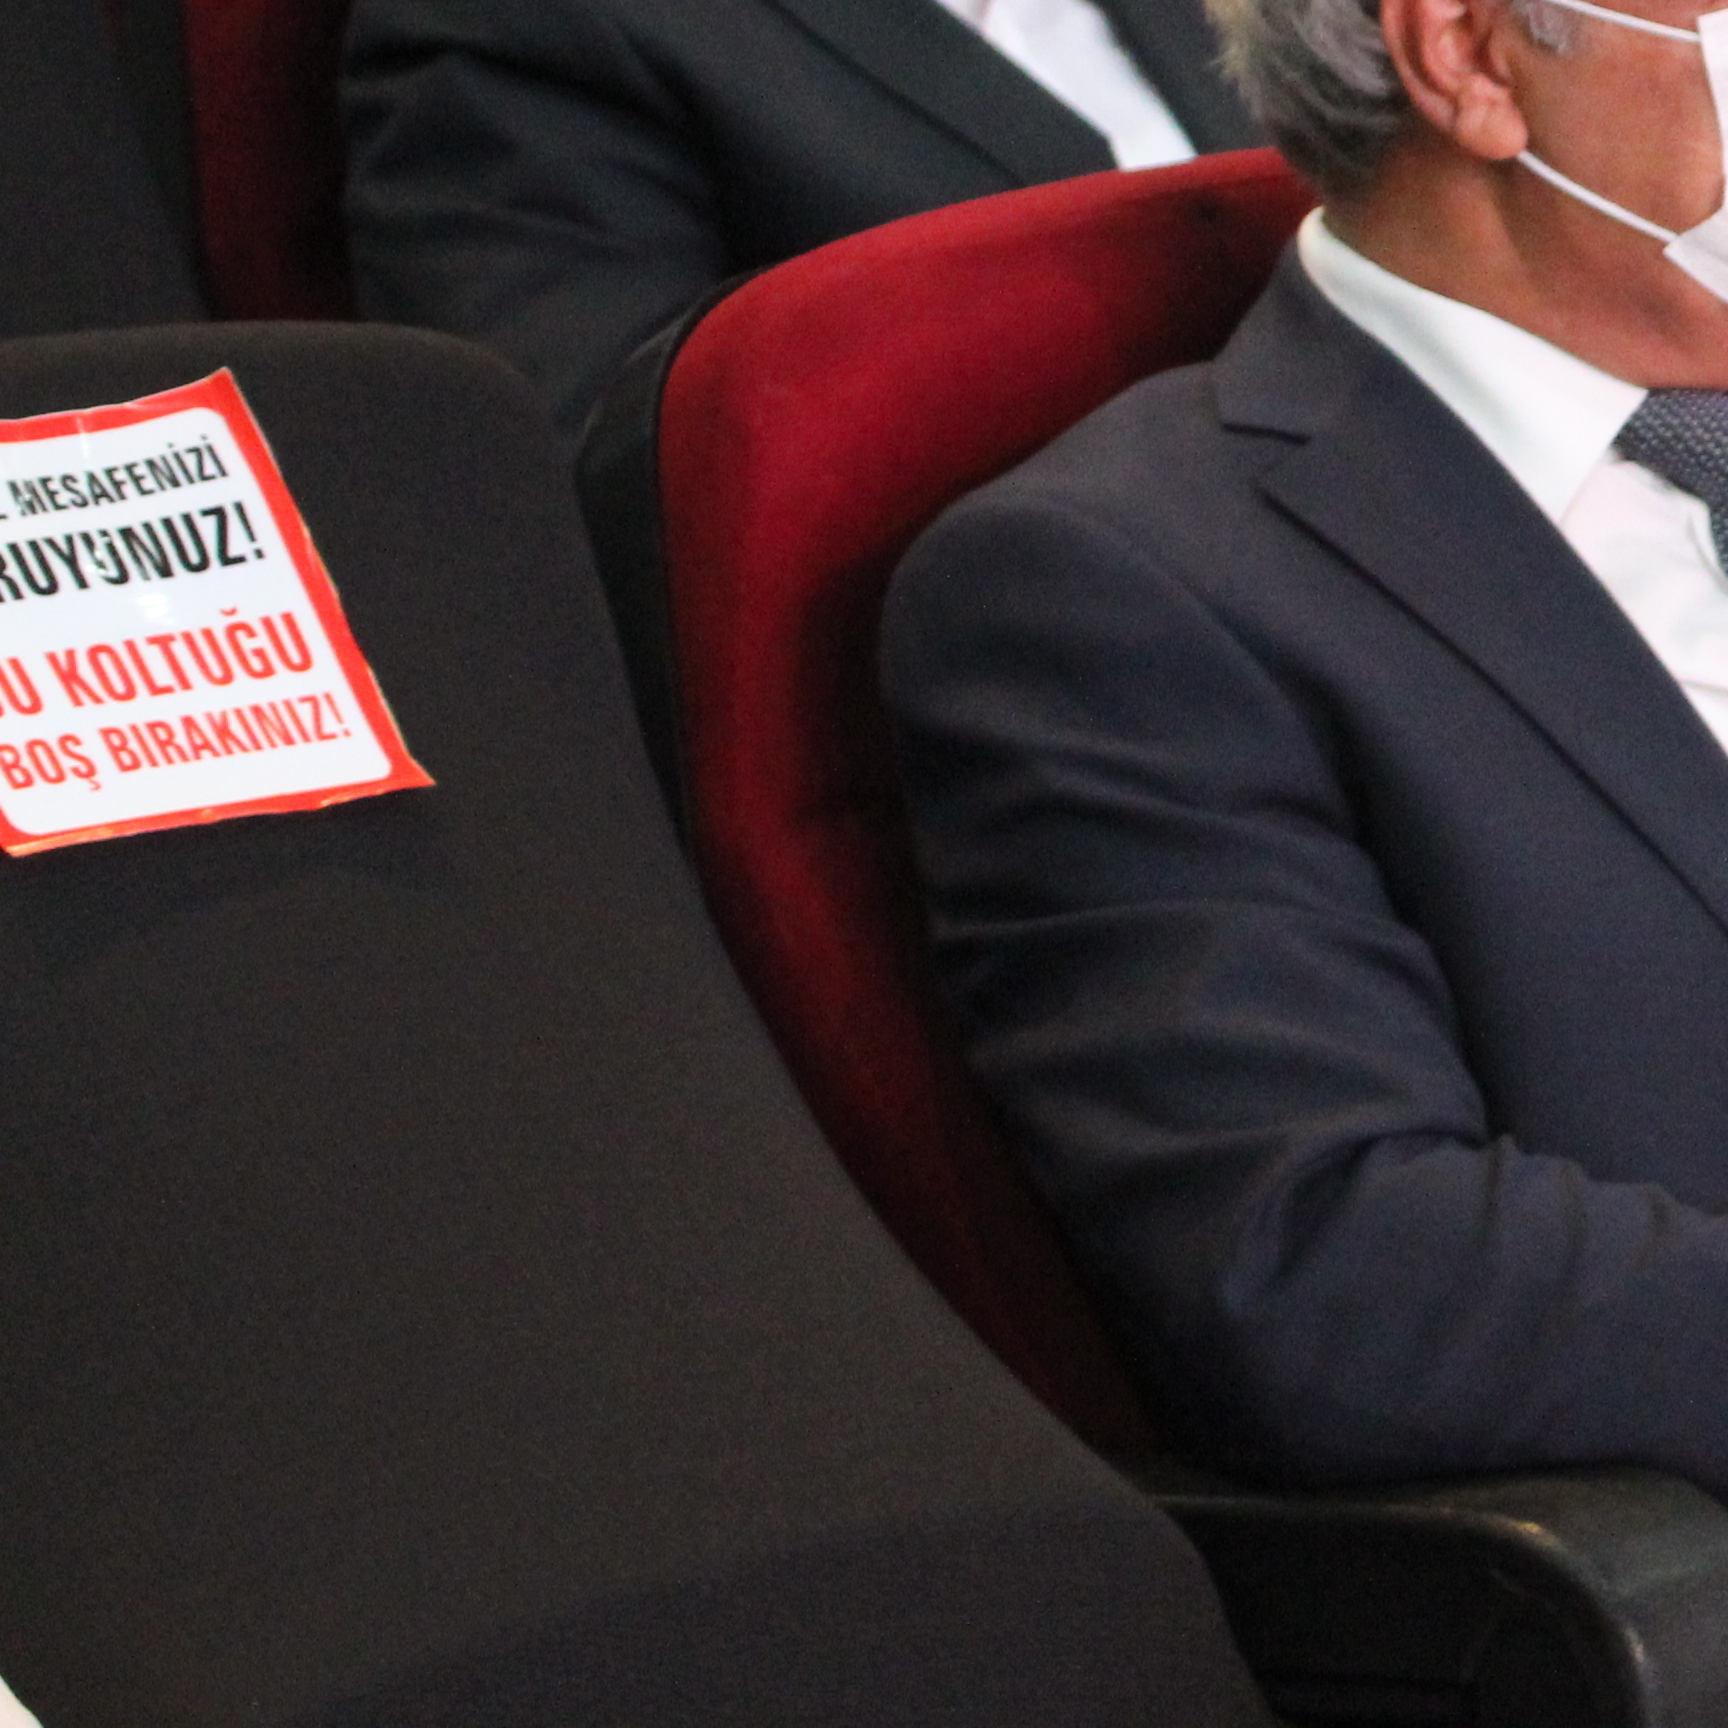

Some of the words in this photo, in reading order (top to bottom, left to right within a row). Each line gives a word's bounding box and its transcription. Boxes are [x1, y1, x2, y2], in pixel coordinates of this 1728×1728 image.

[7, 433, 229, 517] MESAFENİZİ
[44, 606, 314, 708] KOLTUĞU
[0, 743, 102, 792] BOŞ
[97, 692, 353, 773] BIRAKINIZ!
